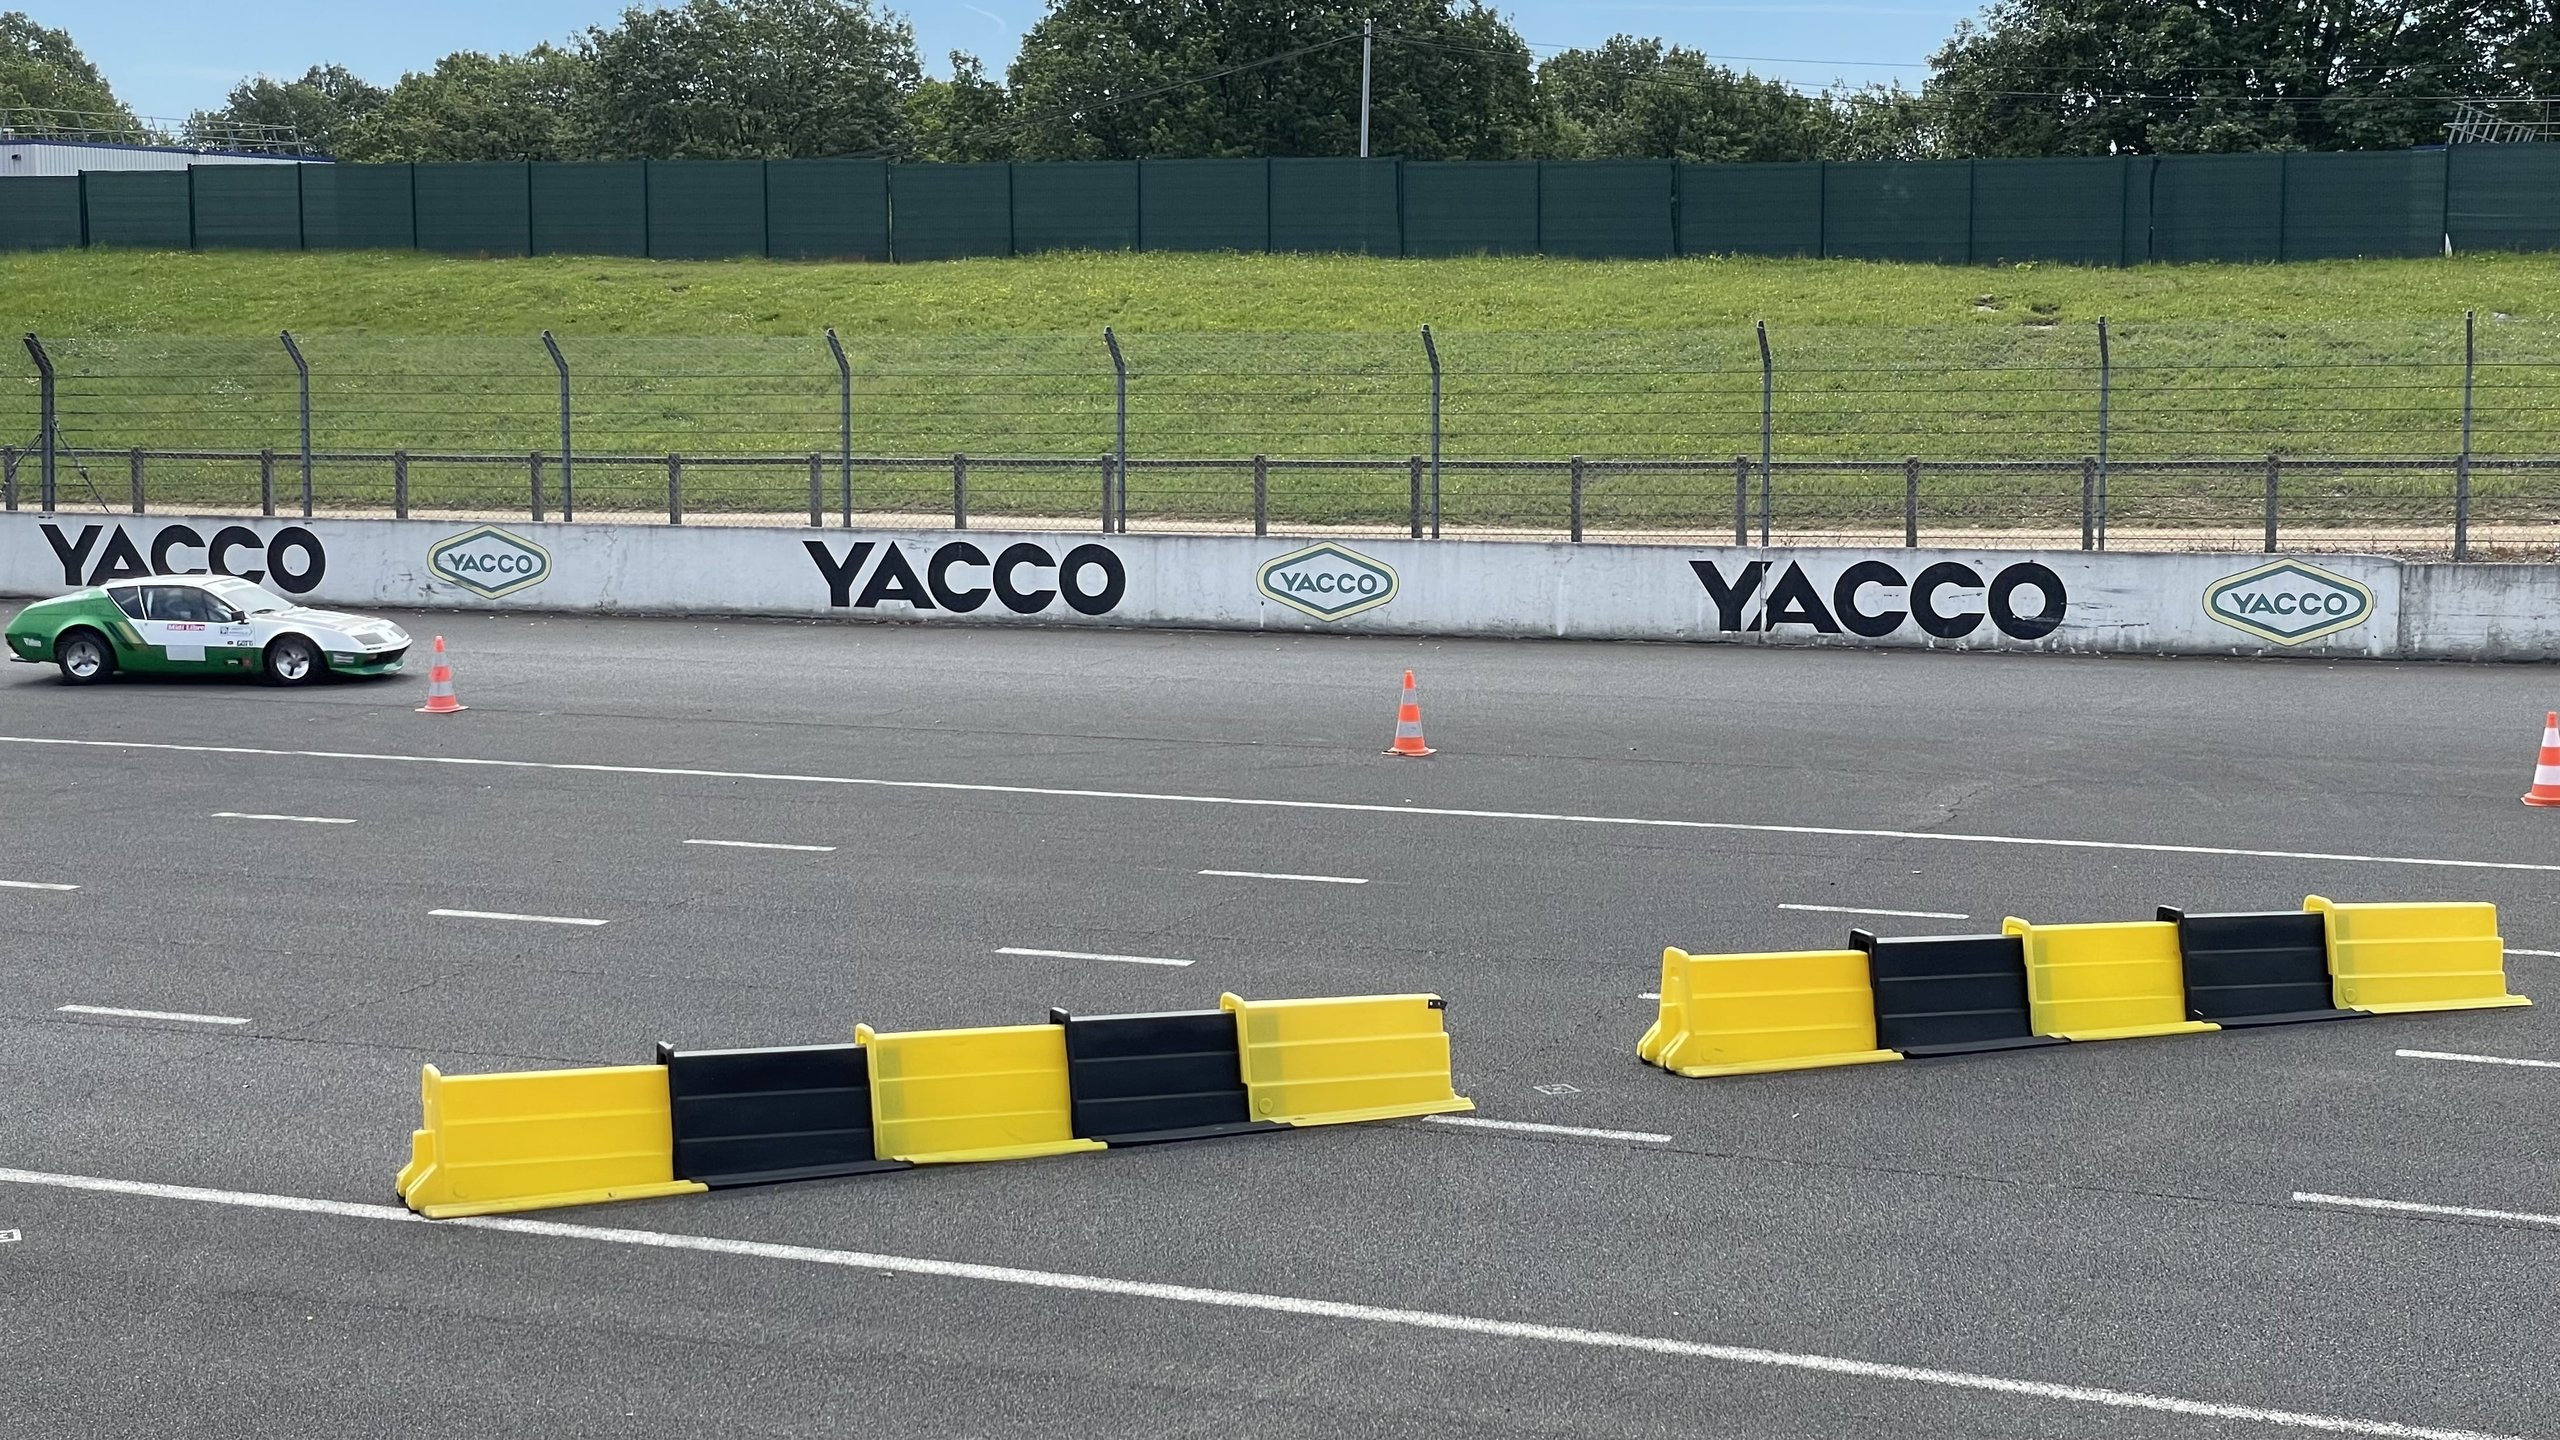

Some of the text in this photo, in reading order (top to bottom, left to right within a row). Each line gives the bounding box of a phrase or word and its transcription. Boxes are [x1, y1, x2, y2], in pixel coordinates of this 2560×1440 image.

[39, 523, 326, 594] YACCO
[447, 553, 533, 575] YACCO
[802, 540, 1126, 616] YACCO
[1279, 572, 1378, 595] YACCO
[1688, 559, 2068, 641] YACCO
[2230, 592, 2348, 616] YACCO
